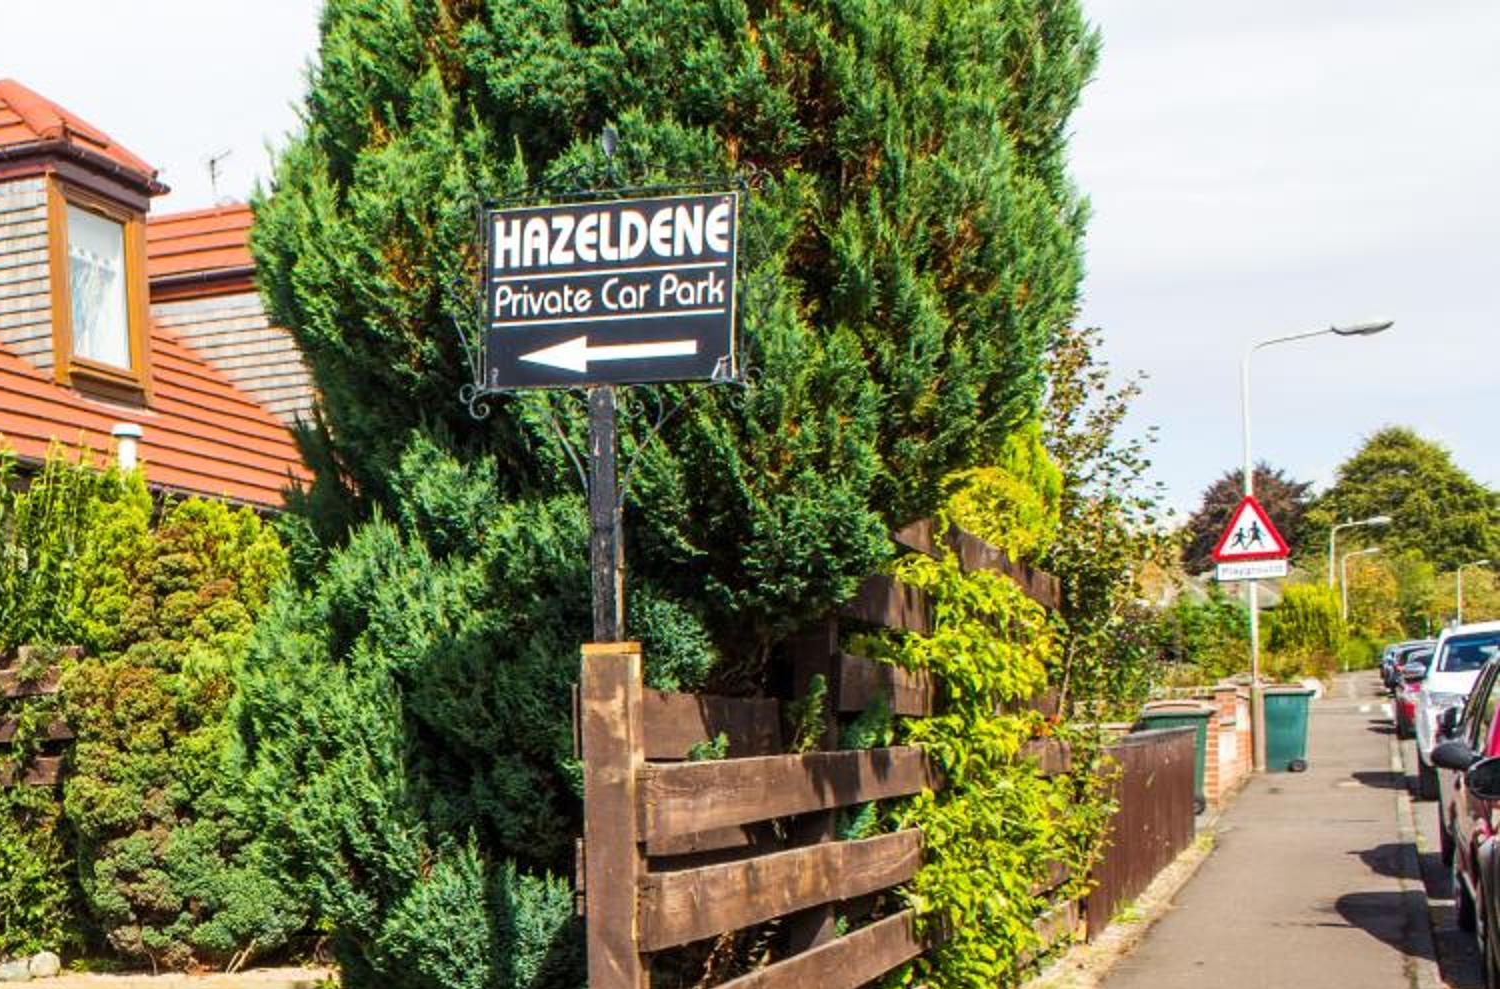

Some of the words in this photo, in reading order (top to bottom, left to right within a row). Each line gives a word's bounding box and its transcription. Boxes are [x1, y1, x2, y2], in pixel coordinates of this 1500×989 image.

[494, 205, 729, 268] HAZELDENE
[495, 285, 592, 317] Private
[602, 278, 651, 310] Car
[659, 271, 725, 307] Park
